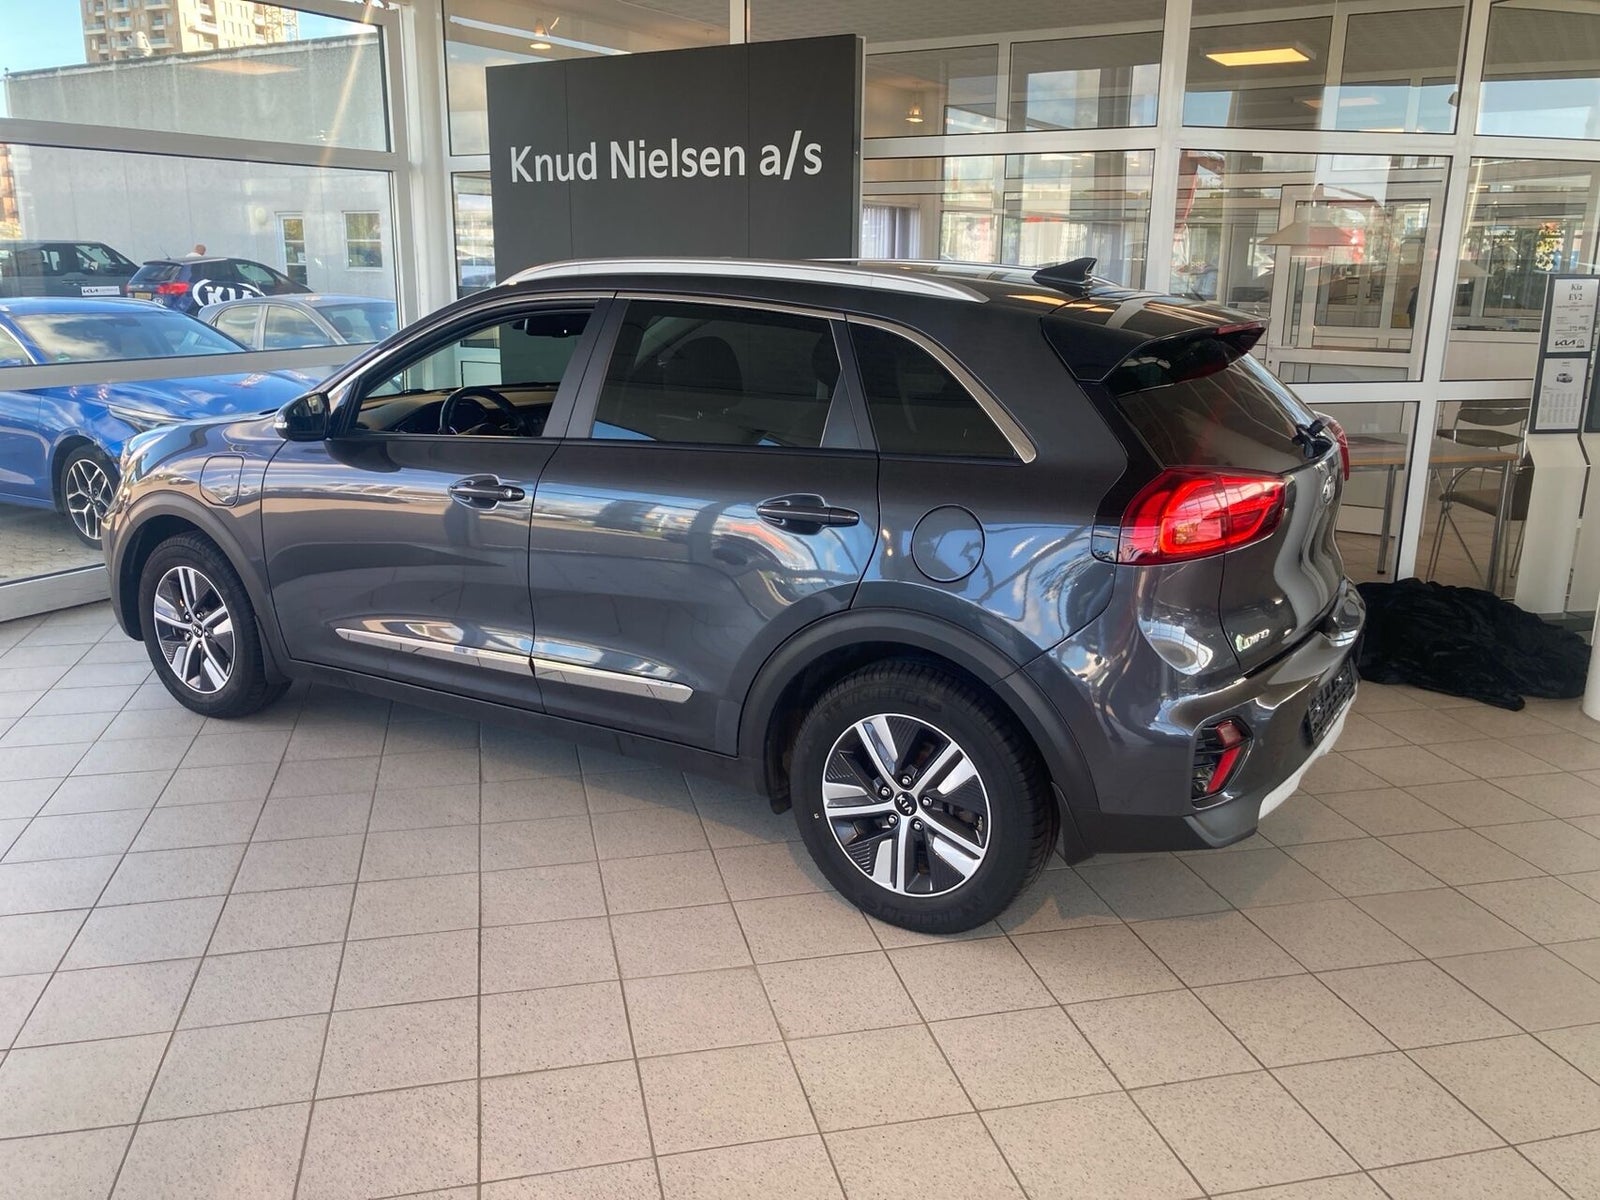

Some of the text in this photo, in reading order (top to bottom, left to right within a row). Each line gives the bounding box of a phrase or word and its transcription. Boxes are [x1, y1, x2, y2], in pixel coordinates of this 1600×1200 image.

[510, 130, 823, 183] Knud Nielsen a/s
[896, 794, 913, 815] KIA
